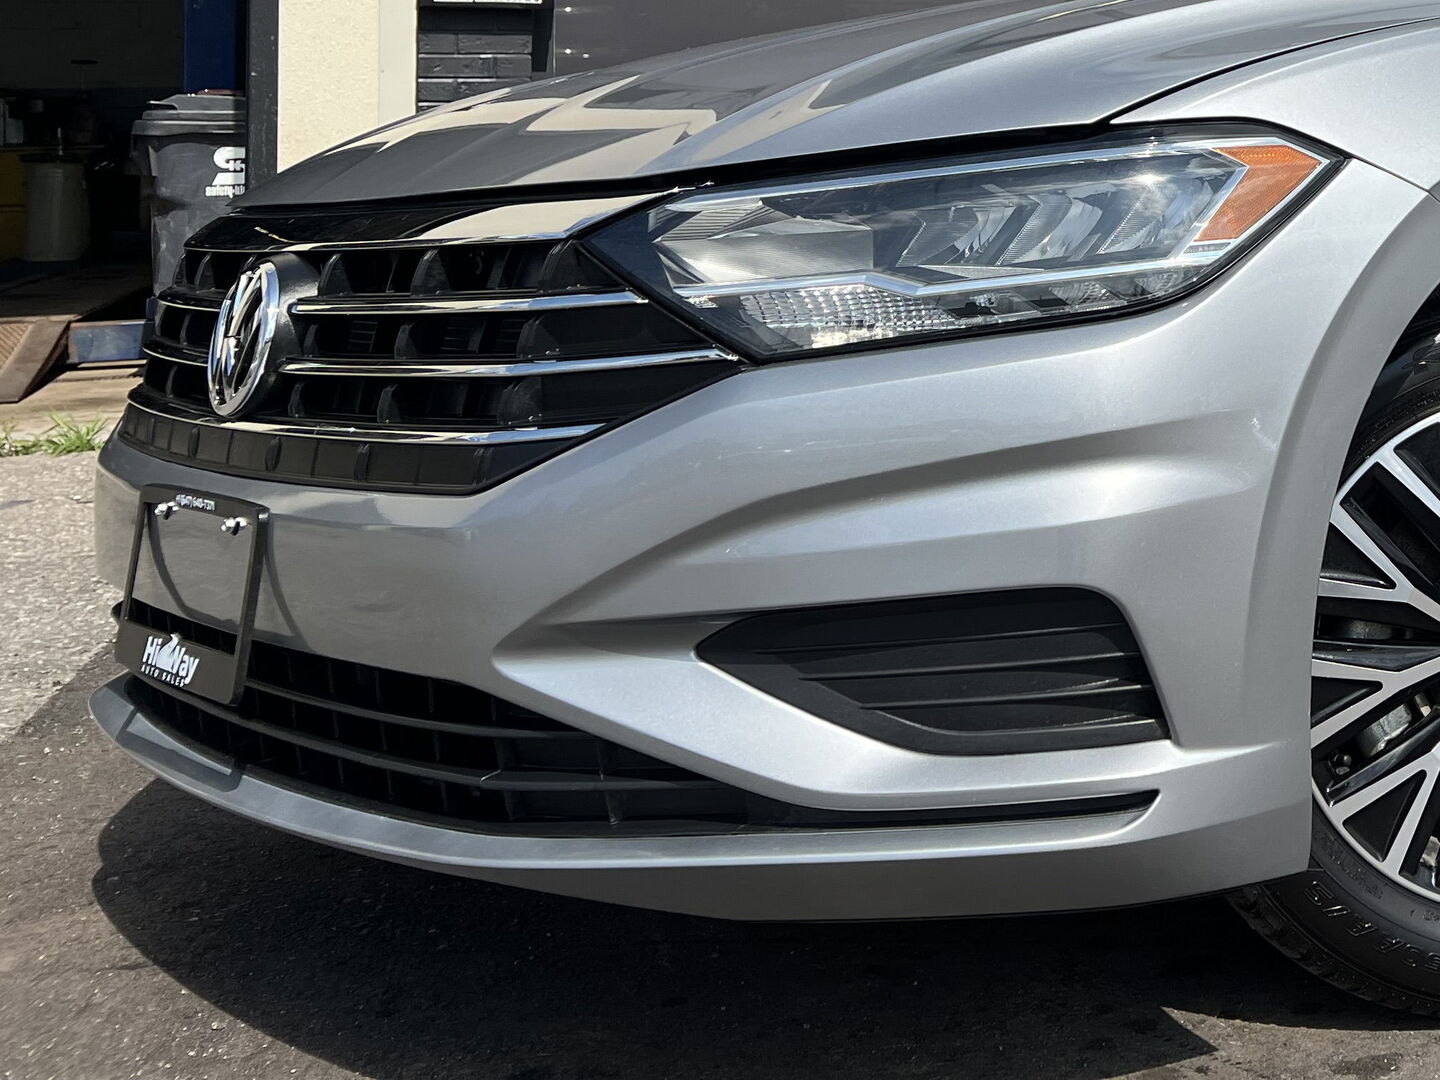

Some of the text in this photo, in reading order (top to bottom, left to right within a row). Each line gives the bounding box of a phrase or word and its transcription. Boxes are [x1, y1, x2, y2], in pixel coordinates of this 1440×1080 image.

[142, 635, 164, 666] Hi
[140, 664, 186, 688] AUTO SALES
